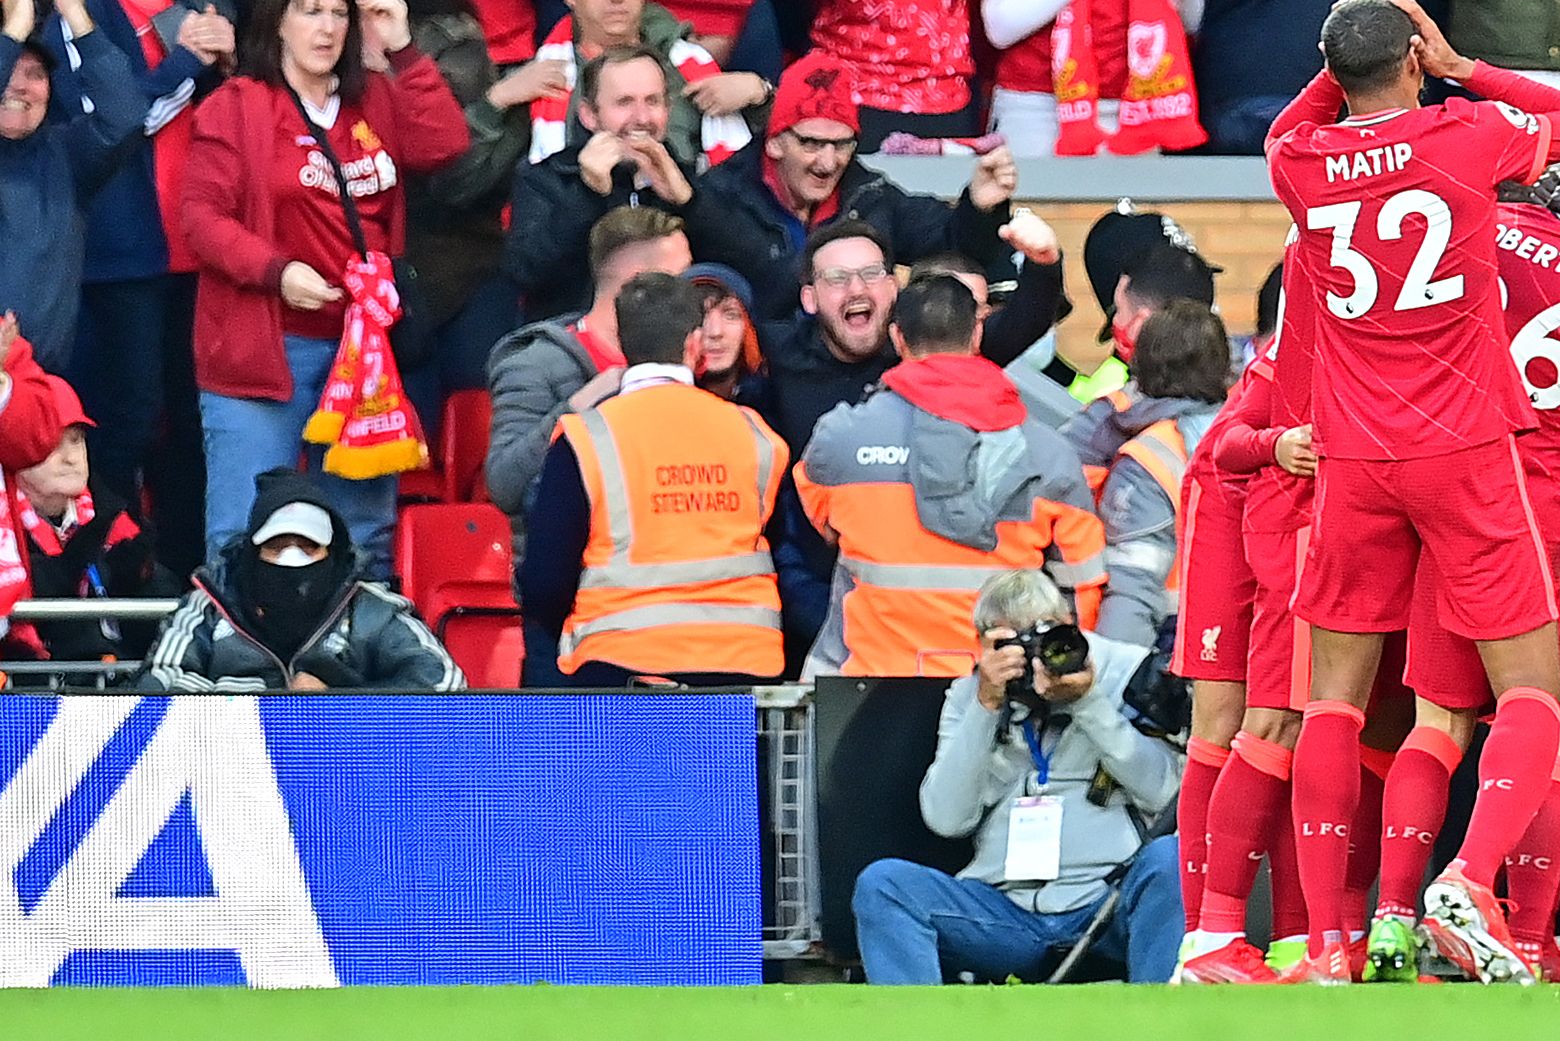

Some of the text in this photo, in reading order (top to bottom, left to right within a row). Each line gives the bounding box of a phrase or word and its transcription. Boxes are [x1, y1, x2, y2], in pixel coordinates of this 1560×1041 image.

[1325, 141, 1413, 184] MATIP
[1306, 189, 1465, 320] 32
[655, 464, 728, 487] CROWD
[652, 490, 741, 514] STEWARD
[1302, 821, 1348, 838] LFC
[1386, 824, 1433, 845] LFC
